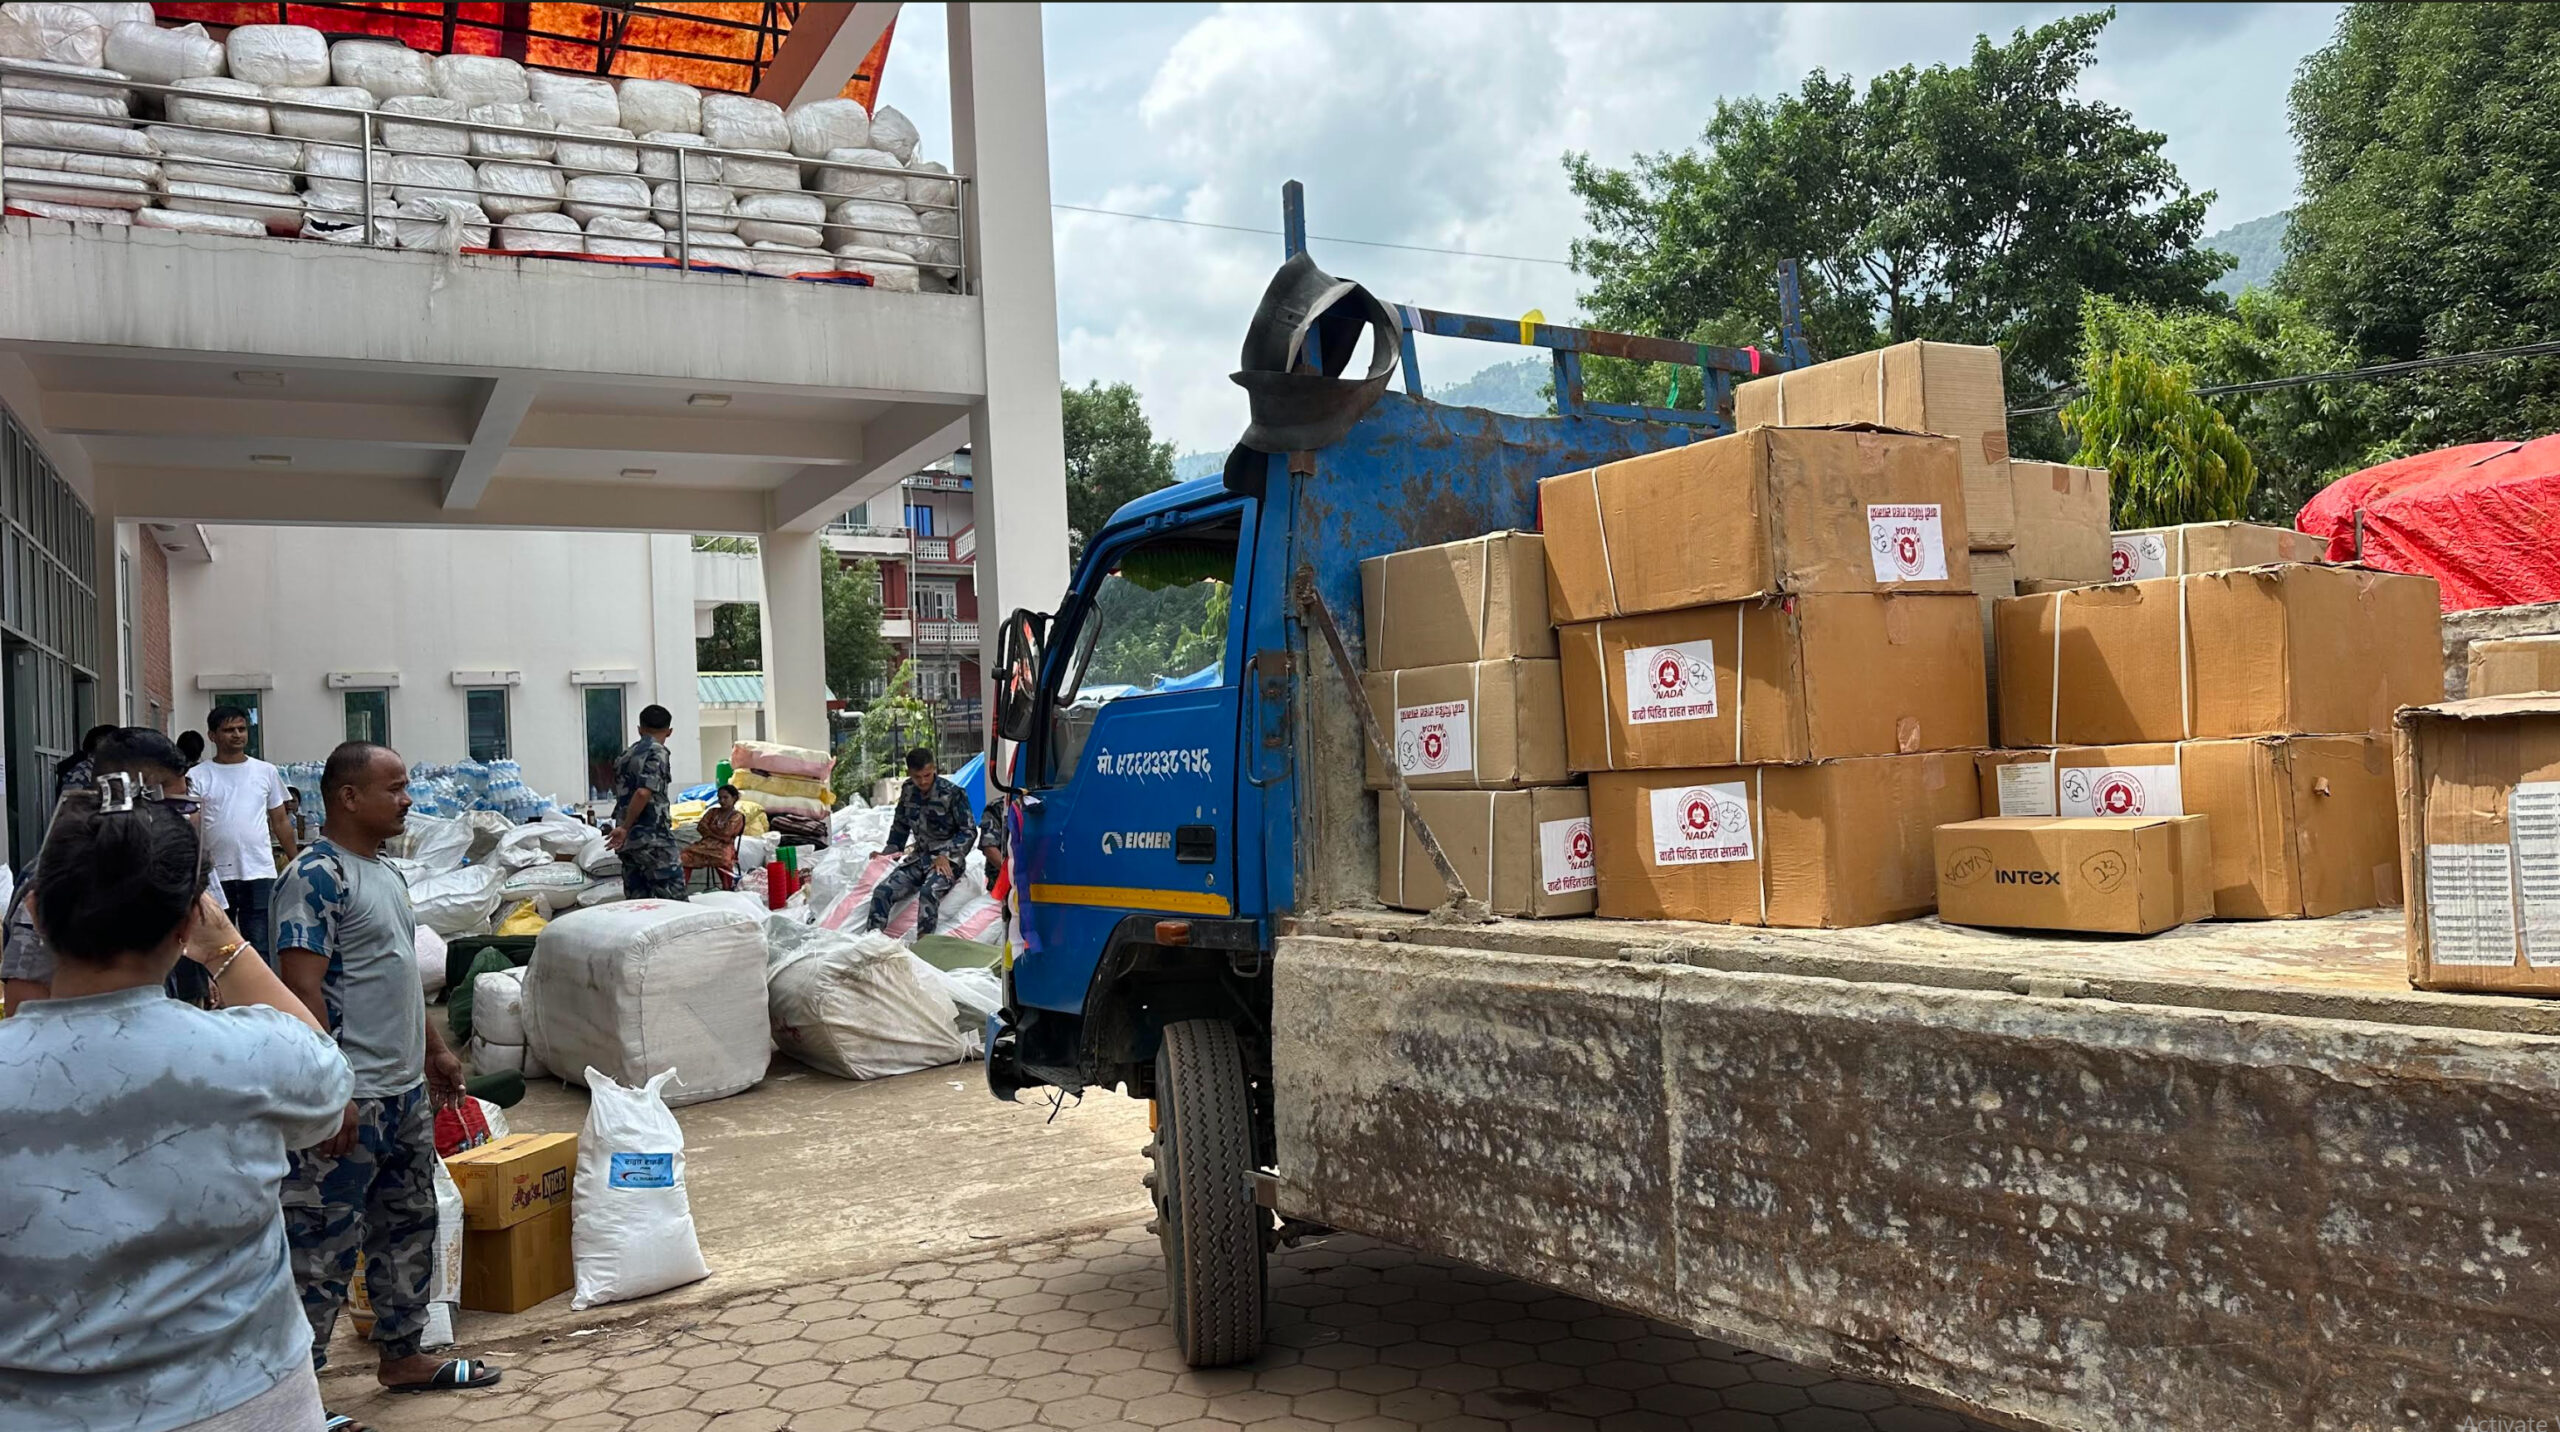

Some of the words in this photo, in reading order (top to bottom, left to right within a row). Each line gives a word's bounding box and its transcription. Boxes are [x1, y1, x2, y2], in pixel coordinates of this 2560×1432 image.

[1895, 526, 1917, 535] NADA
[1656, 689, 1683, 699] NADA
[1669, 706, 1686, 717] राहत
[1422, 723, 1444, 733] NADA
[1125, 832, 1171, 848] EICHER
[1685, 831, 1715, 841] NADA
[1699, 847, 1719, 860] राहत
[1571, 860, 1595, 870] NADA
[1945, 856, 1992, 880] NADA
